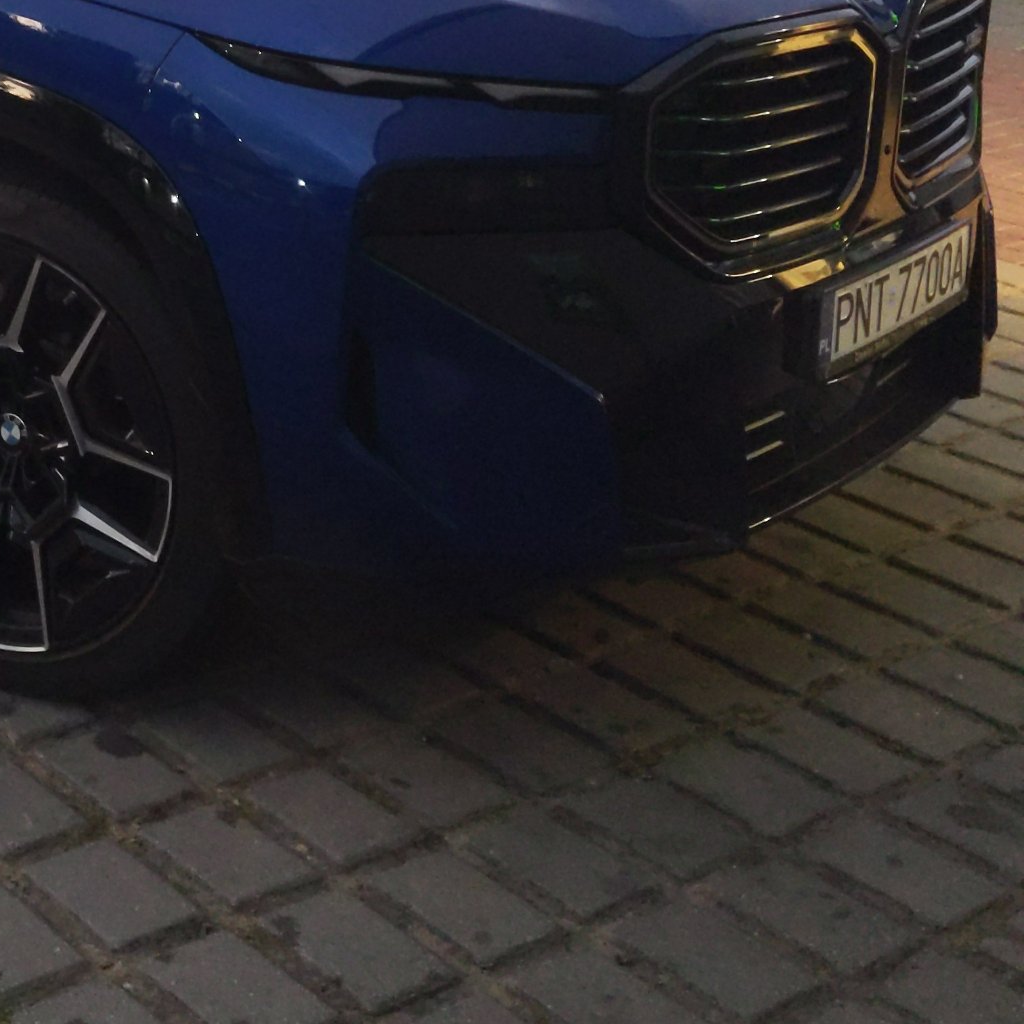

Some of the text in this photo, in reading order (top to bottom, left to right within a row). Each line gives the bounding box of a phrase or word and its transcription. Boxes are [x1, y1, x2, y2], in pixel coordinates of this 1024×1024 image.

[834, 235, 963, 353] PNT 7700A
[818, 338, 830, 356] PL
